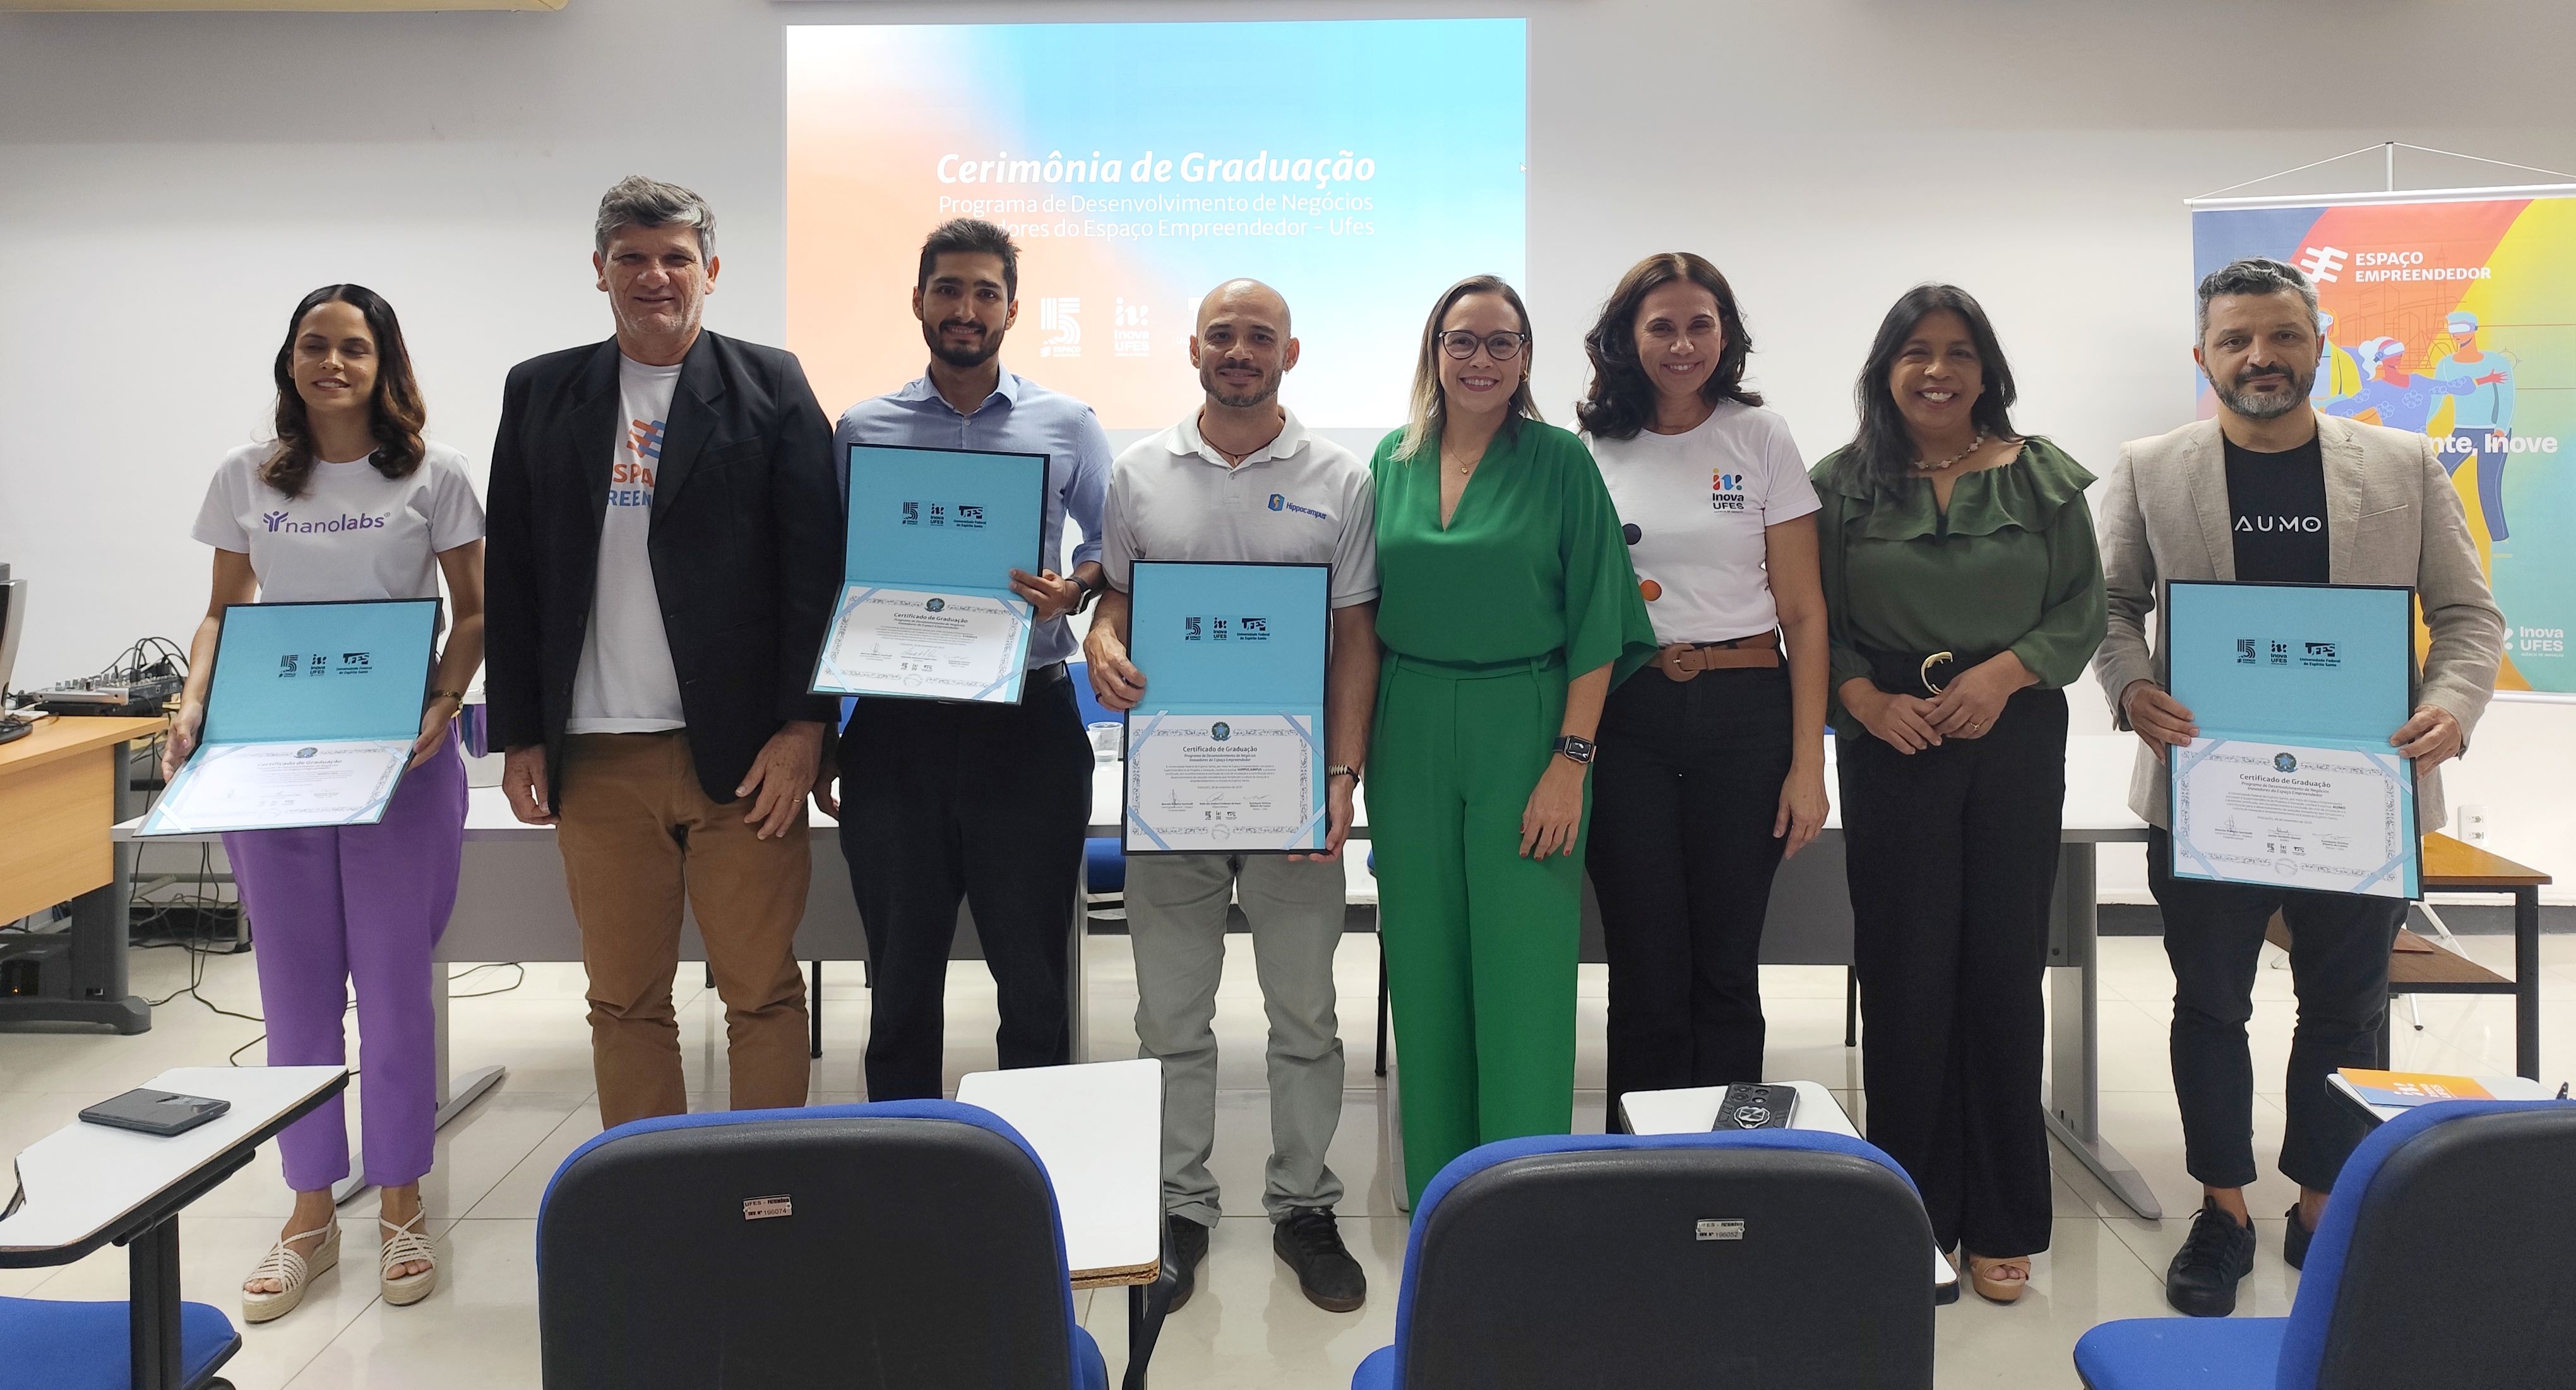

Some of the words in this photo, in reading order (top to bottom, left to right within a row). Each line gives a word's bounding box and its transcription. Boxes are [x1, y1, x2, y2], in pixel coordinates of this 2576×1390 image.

[936, 150, 1123, 184] Cerimônia
[1130, 150, 1173, 183] de
[1179, 149, 1376, 189] Graduação
[939, 195, 1037, 217] Programa
[1042, 193, 1067, 213] de
[1071, 193, 1249, 213] Desenvolvimento
[1252, 192, 1277, 212] de
[1282, 191, 1374, 217] Negócios
[997, 218, 1049, 237] dores
[1054, 218, 1080, 237] do
[1084, 219, 1154, 242] Espaço
[1158, 217, 1309, 242] Empreendedor
[1330, 216, 1375, 237] Ufes
[2355, 251, 2423, 268] ESPAÇO
[2355, 267, 2491, 282] EMPREENDEDOR
[1114, 330, 1150, 341] Inova
[1114, 340, 1150, 352] UFES
[2428, 433, 2478, 456] nte,
[2484, 433, 2558, 454] Inove
[613, 463, 655, 488] SPA
[1712, 493, 1744, 502] Inova
[1286, 502, 1327, 520] Hippocampus
[2234, 515, 2322, 533] AUMO
[2520, 626, 2564, 638] Inova
[2520, 639, 2563, 651] UFES
[2239, 773, 2280, 783] Certificado
[2291, 778, 2331, 788] Graduação
